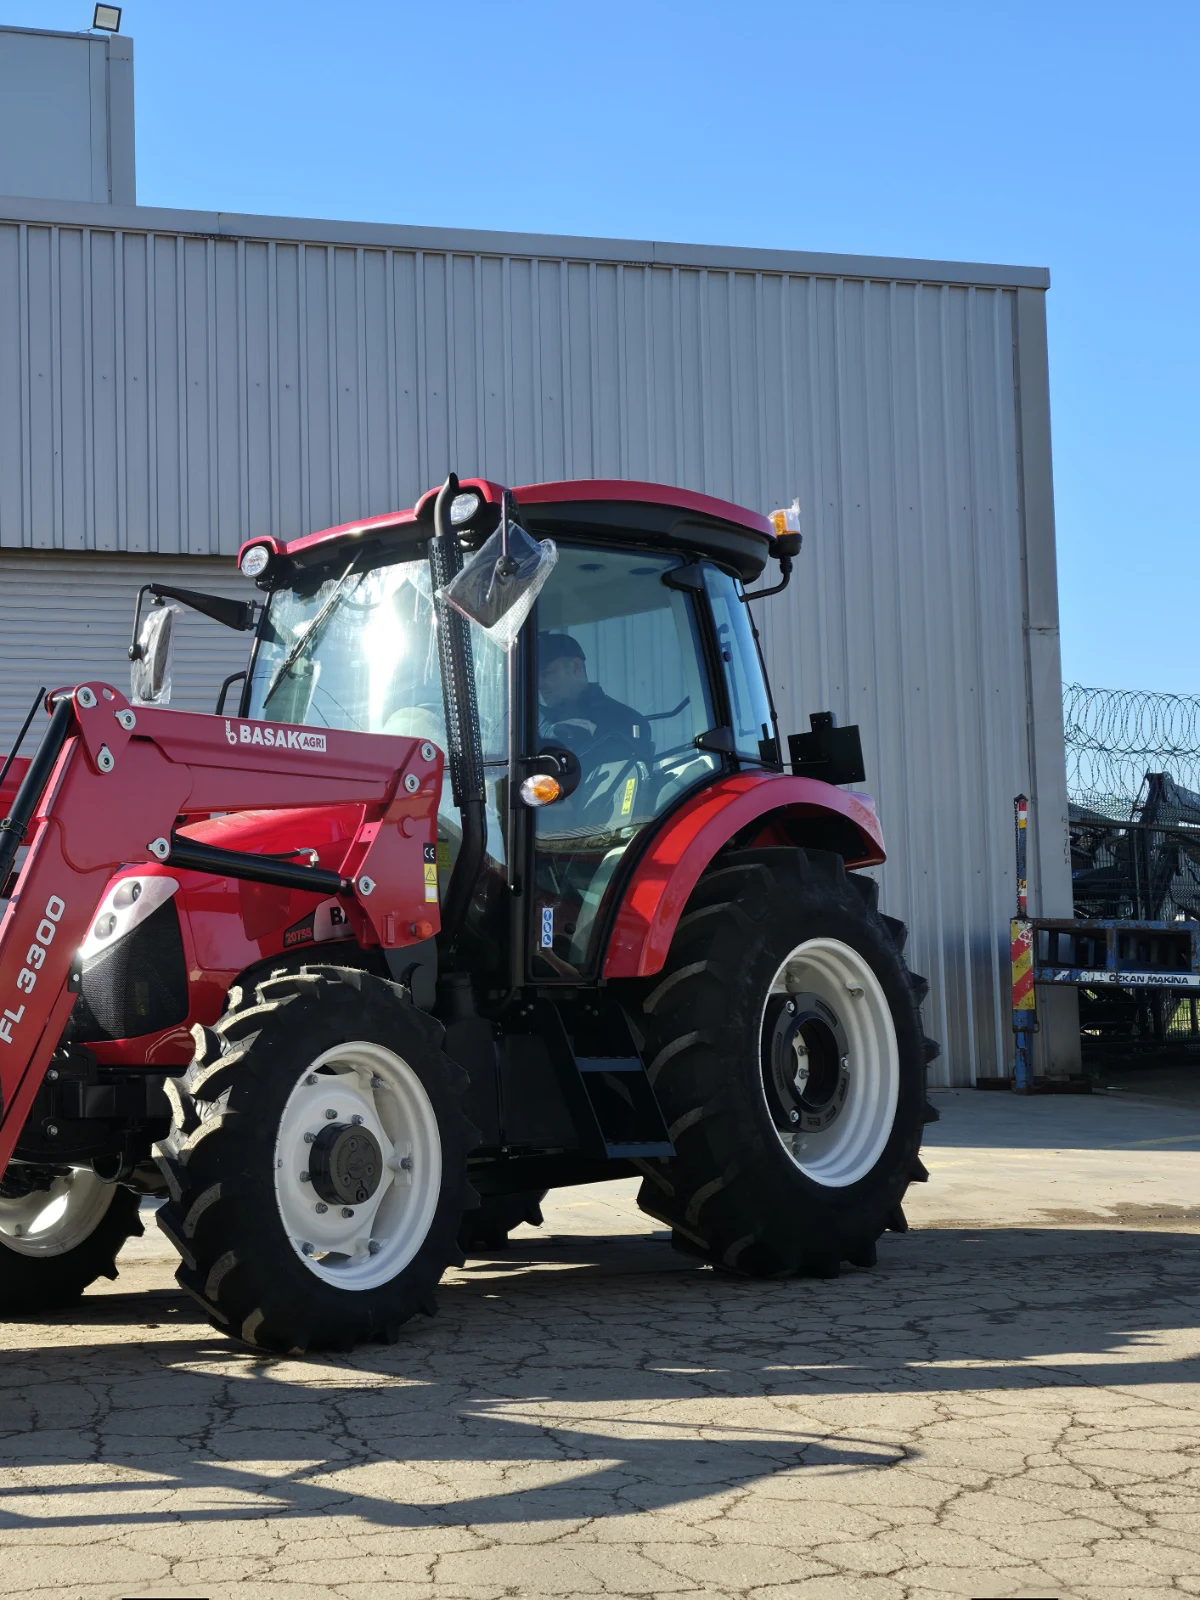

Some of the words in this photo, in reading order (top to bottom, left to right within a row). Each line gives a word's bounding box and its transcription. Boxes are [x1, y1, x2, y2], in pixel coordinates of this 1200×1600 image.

[240, 725, 301, 749] BASAK
[302, 736, 325, 749] AGRI
[16, 894, 66, 994] 3300
